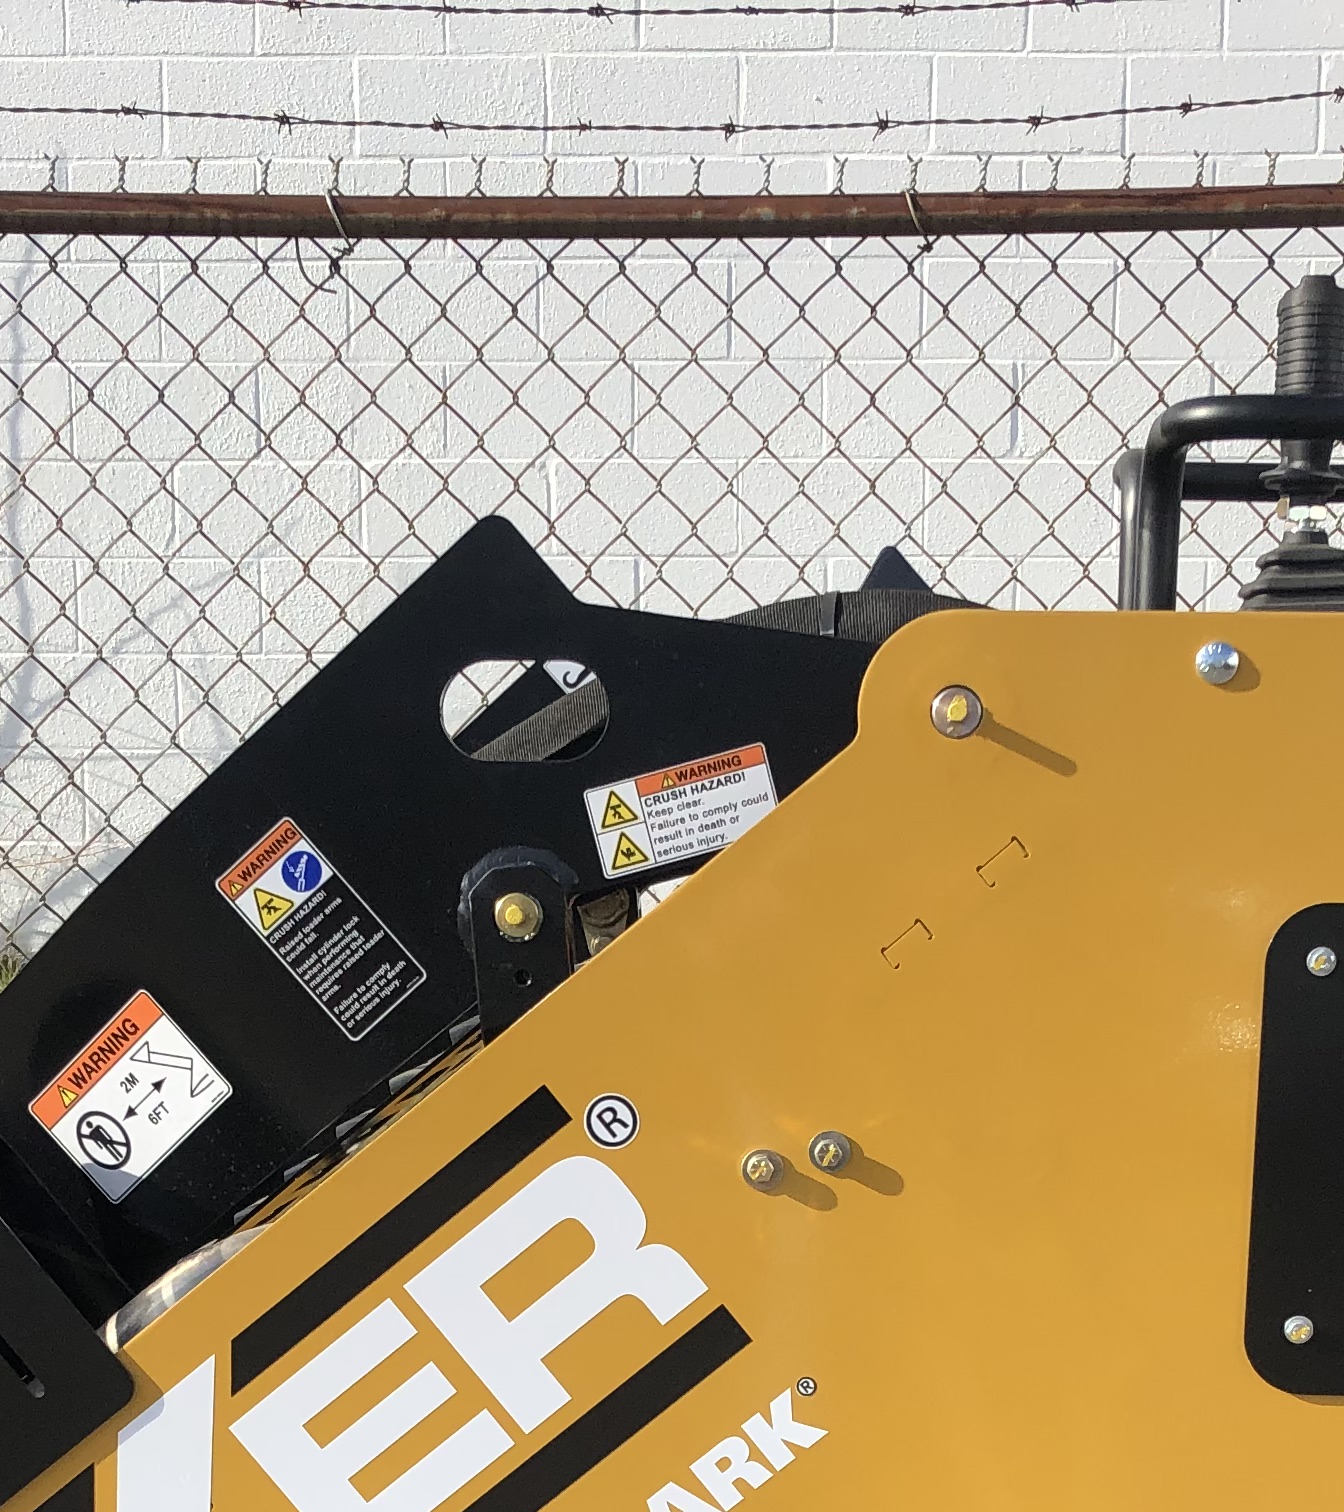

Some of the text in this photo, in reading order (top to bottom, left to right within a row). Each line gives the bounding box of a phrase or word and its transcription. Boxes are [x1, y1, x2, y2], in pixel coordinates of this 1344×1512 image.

[674, 754, 742, 782] WARNING
[644, 771, 745, 807] CRUSH HAZARD!
[646, 798, 704, 819] Keep clear.
[649, 791, 768, 832] Failure to comply could
[653, 814, 739, 845] result in death or
[237, 827, 297, 882] WARNING
[656, 832, 727, 857] serious injury.
[269, 918, 295, 944] CRUSH
[278, 897, 342, 955] Raised loader arms
[285, 931, 319, 962] could fall.
[295, 915, 359, 974] Install cylinder lock
[302, 929, 359, 980] when performing
[308, 935, 365, 988] maintenance that
[315, 929, 384, 995] requires raised loader
[321, 984, 341, 1001] arms.
[333, 991, 358, 1014] Failure
[356, 985, 365, 993] to
[365, 962, 390, 987] comply
[340, 1001, 360, 1021] could
[359, 983, 380, 1004] result
[377, 977, 387, 986] in
[386, 960, 406, 979] death
[346, 1018, 355, 1028] or
[354, 996, 380, 1020] serious
[377, 978, 401, 998] injury.
[66, 1017, 139, 1089] WARNING
[119, 1072, 139, 1093] 2M
[147, 1100, 169, 1124] 6FT
